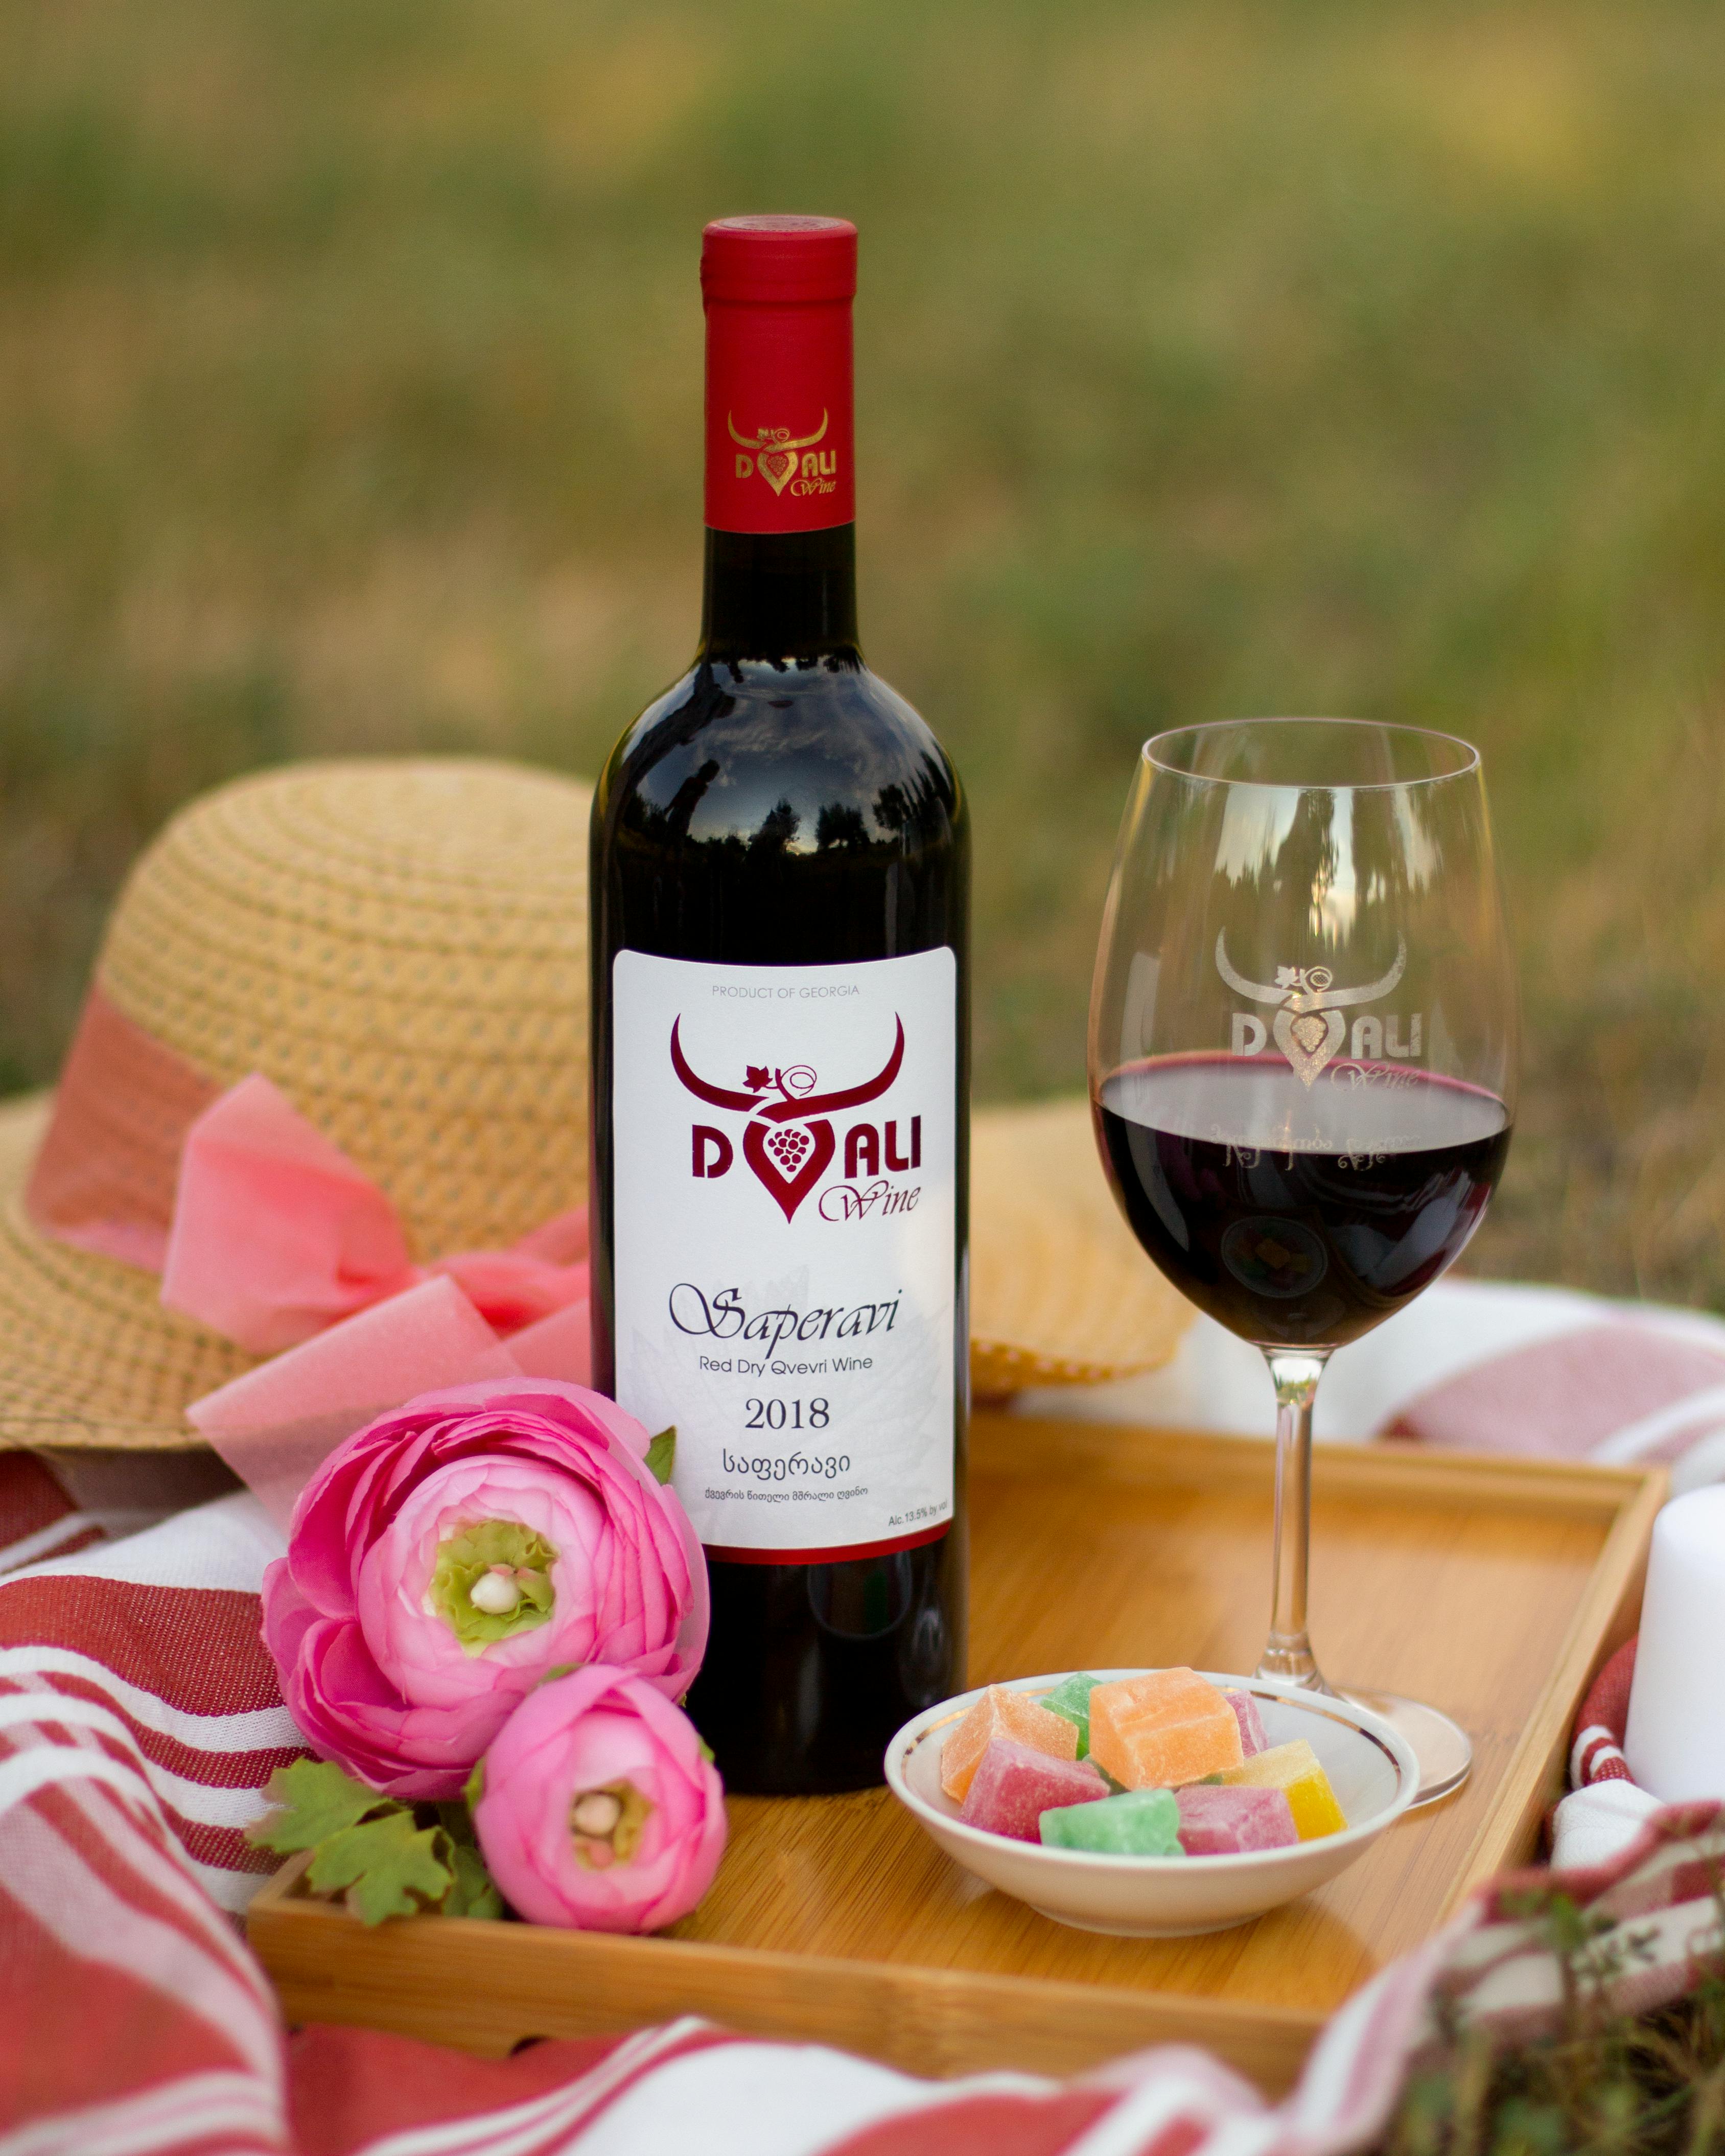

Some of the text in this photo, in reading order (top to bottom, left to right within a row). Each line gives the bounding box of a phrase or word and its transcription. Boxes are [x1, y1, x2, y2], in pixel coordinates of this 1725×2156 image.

[791, 478, 836, 496] Wine
[712, 985, 860, 999] PRODUCT OF GEORGIA
[1331, 1061, 1419, 1092] Wine
[819, 1180, 921, 1222] Wine
[669, 1283, 902, 1360] Saperavi
[700, 1356, 873, 1378] Red Dry Qvevri Wine
[744, 1398, 830, 1430] 2018
[723, 1448, 850, 1481] საფერავი
[705, 1486, 868, 1503] ქვევრის წითელი მშრალი ღვინო
[929, 1504, 938, 1517] by
